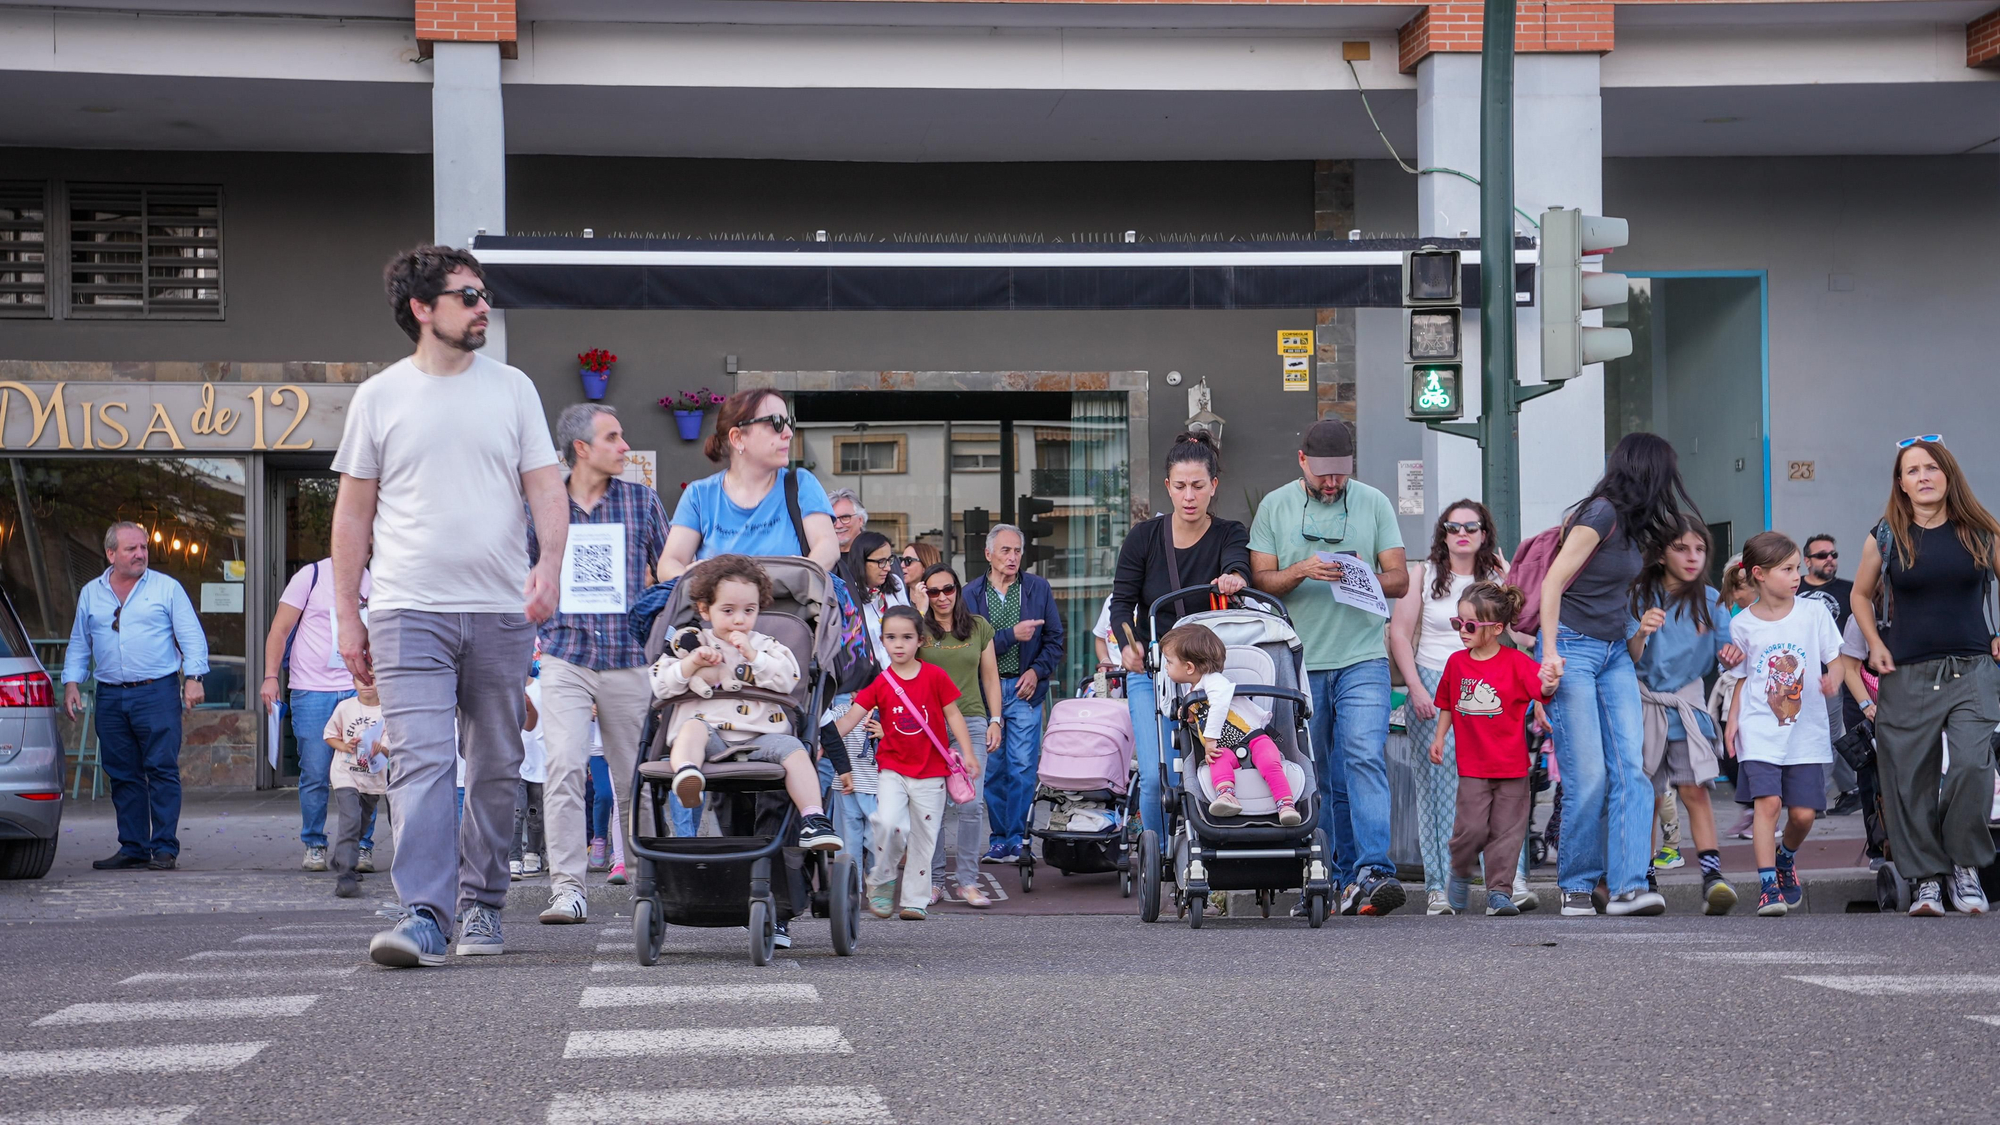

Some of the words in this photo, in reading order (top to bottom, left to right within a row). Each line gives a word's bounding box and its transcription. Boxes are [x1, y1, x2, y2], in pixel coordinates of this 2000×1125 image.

[191, 382, 241, 435] de
[247, 385, 313, 450] 12
[1790, 462, 1813, 479] 23
[1756, 654, 1766, 673] DONT
[1461, 678, 1477, 686] EASY
